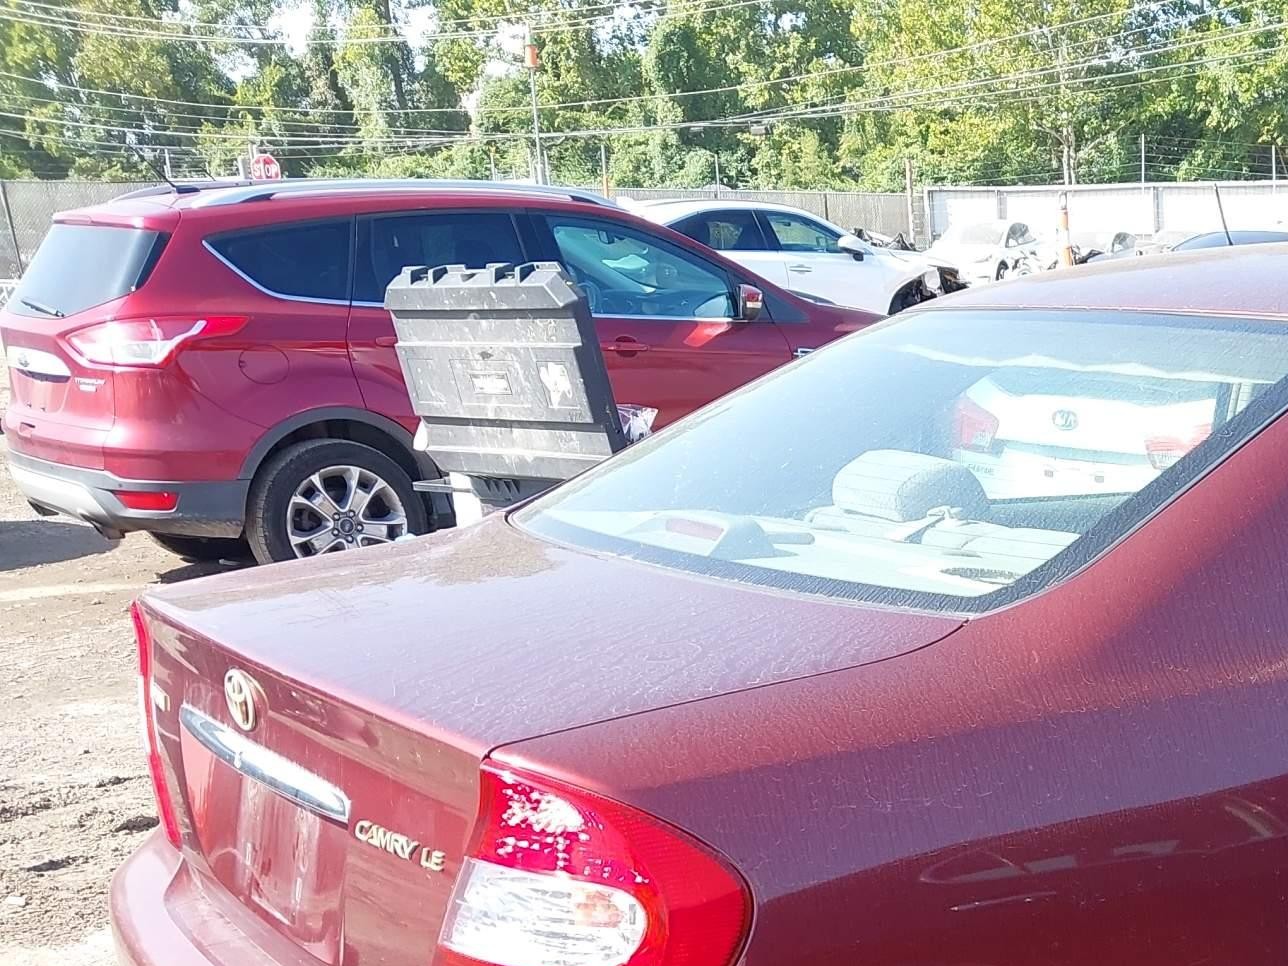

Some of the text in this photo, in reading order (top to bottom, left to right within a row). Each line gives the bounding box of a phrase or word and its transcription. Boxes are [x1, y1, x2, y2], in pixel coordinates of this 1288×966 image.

[253, 162, 279, 178] STOP
[354, 819, 446, 872] CAMRY LE
